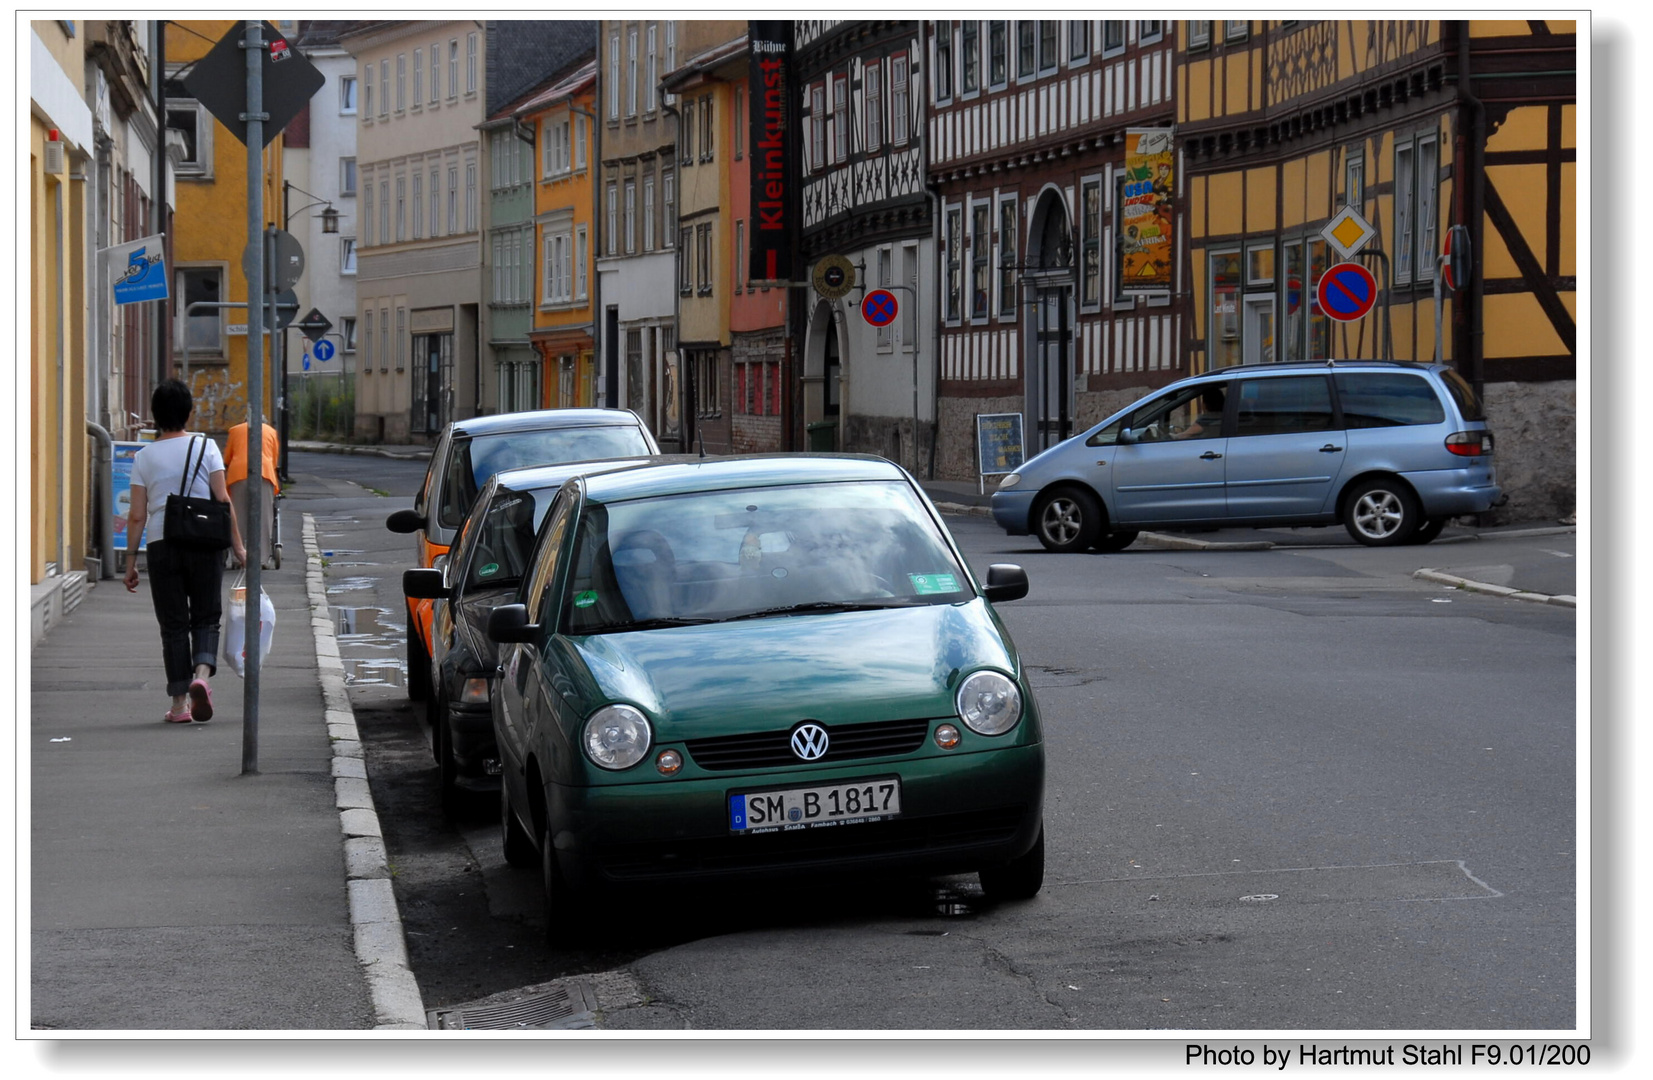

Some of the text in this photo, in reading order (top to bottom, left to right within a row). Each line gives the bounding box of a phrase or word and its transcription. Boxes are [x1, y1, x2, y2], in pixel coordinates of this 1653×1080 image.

[752, 40, 787, 54] Bühne
[758, 58, 783, 230] Kleinkunst
[1125, 180, 1154, 198] USA
[1135, 234, 1167, 247] AFRIKA
[126, 245, 149, 284] 5
[749, 783, 895, 824] SM B 1817
[735, 815, 742, 824] D
[810, 820, 837, 828] Fambach
